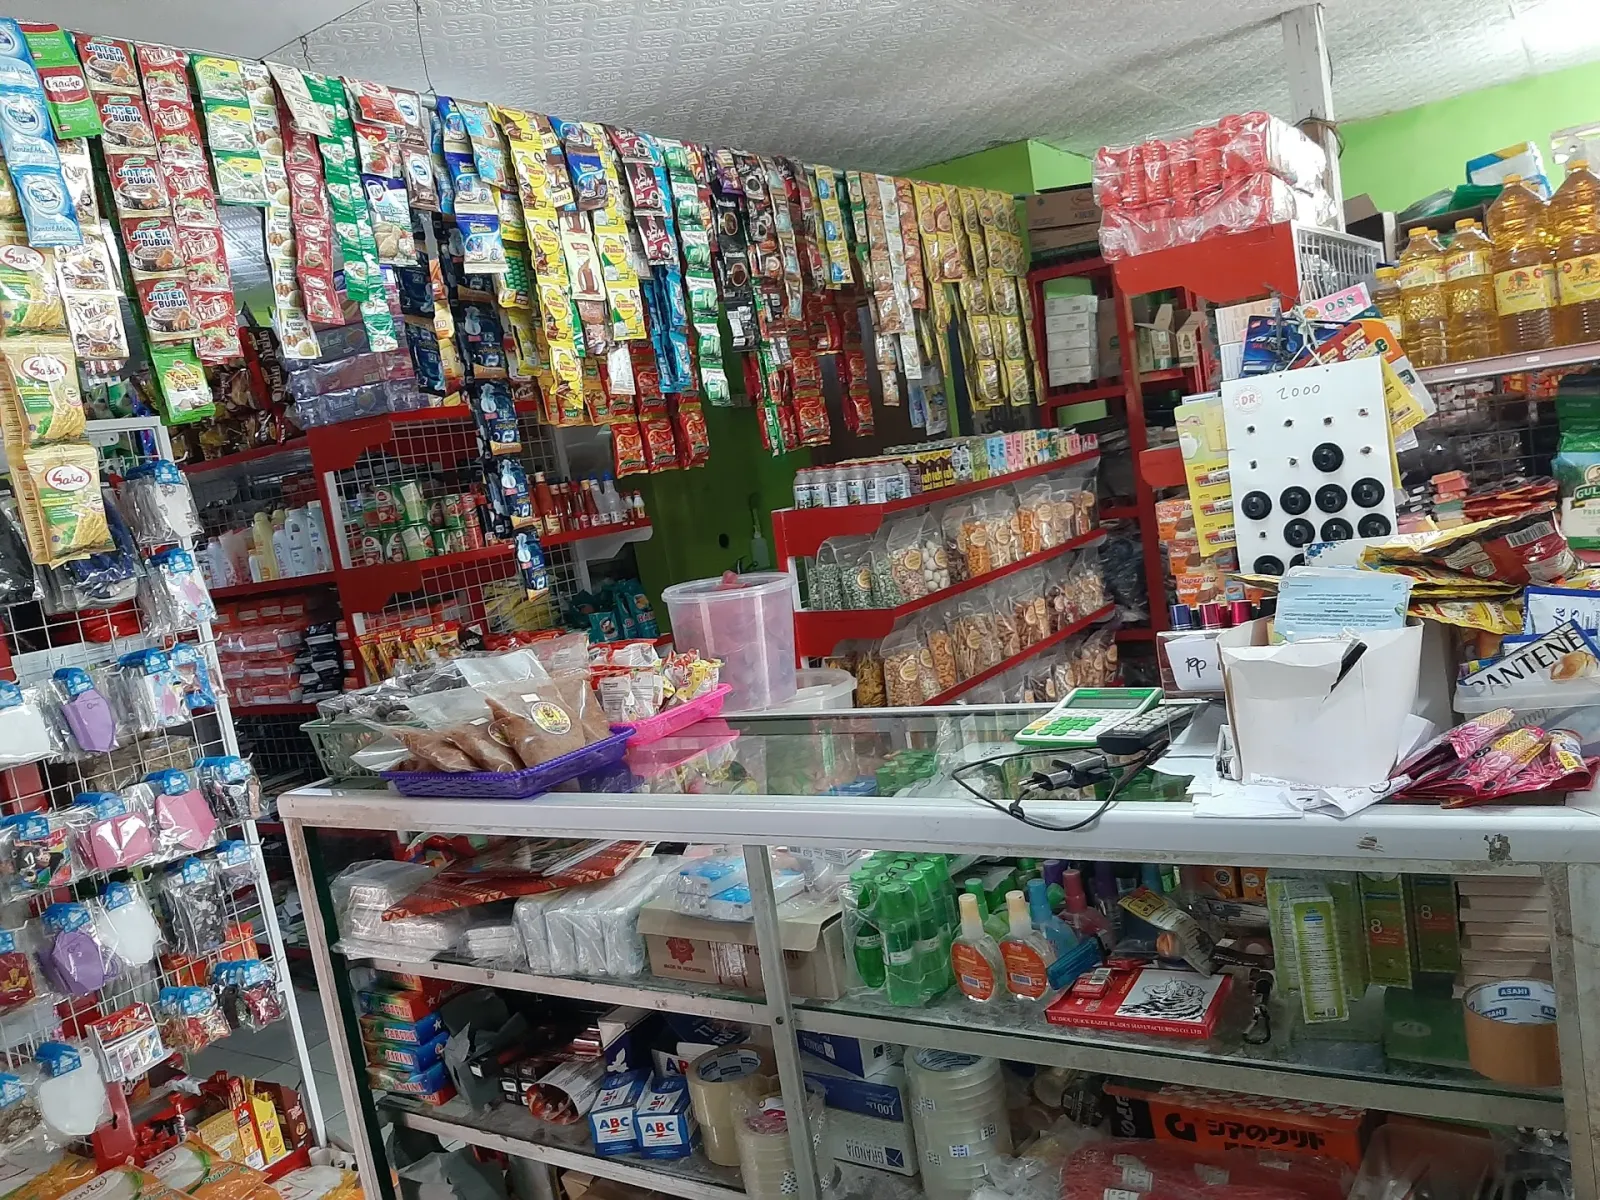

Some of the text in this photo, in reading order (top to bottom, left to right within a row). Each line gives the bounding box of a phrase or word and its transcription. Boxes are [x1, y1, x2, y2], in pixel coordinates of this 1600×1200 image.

[1240, 393, 1256, 405] DR
[1277, 384, 1321, 400] 2000
[51, 469, 85, 487] Sasa
[1421, 904, 1433, 920] 8
[1370, 918, 1383, 934] 8
[1501, 987, 1528, 996] ASAHI
[599, 1116, 631, 1129] ABC
[645, 1121, 675, 1134] ABC
[845, 1143, 885, 1165] GRANDIA
